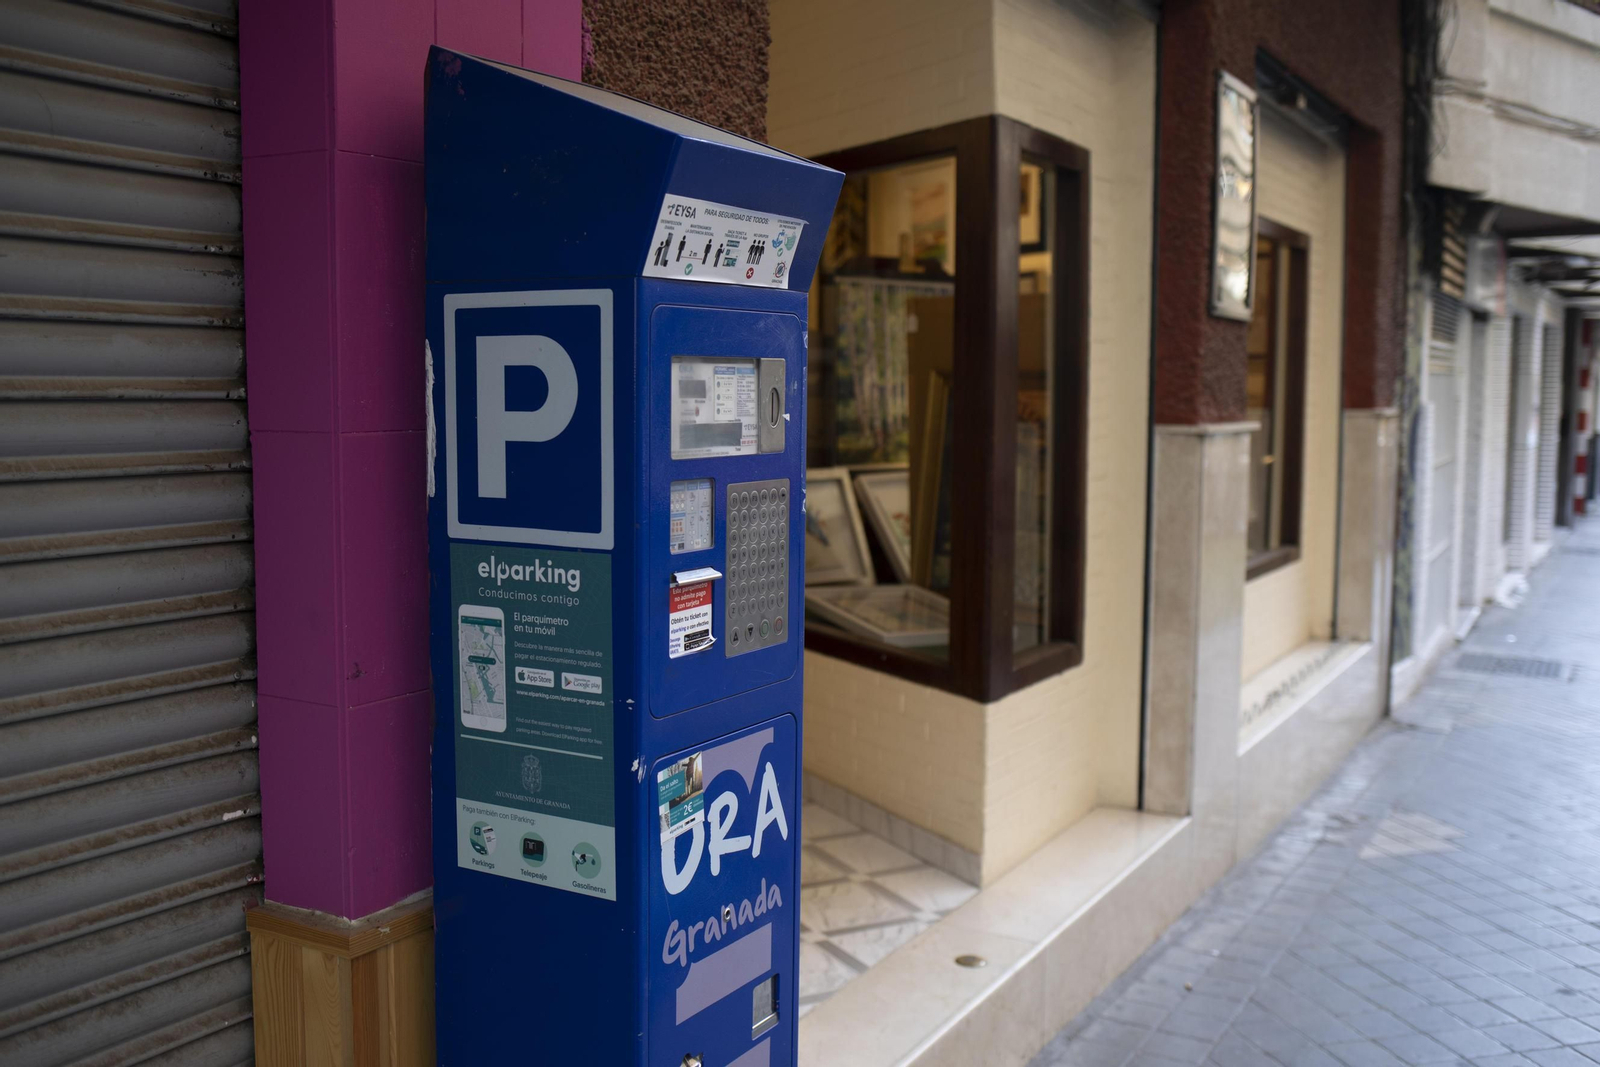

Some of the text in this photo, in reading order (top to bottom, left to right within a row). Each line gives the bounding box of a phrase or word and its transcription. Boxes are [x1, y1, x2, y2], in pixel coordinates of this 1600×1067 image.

[674, 204, 696, 219] EYSA
[718, 210, 745, 221] SEGURIDAD
[476, 334, 578, 498] P
[478, 556, 580, 592] elparking
[478, 587, 580, 607] Conducimos contigo
[686, 600, 699, 608] tarjeta
[514, 612, 569, 626] El parquímetro
[534, 625, 556, 636] móvil
[514, 641, 537, 650] Descubre
[536, 654, 576, 665] estacionamiento
[527, 674, 552, 684] App Store
[573, 681, 590, 689] Google
[495, 791, 535, 803] AYUNTAMIENTO
[544, 799, 570, 810] GRANADA
[462, 804, 475, 814] Paga
[477, 807, 498, 817] también
[684, 802, 693, 815] 2€
[472, 858, 495, 869] Parkings
[521, 869, 548, 881] Telepeaje
[572, 881, 606, 894] Gasolineras
[662, 877, 782, 967] Granada
